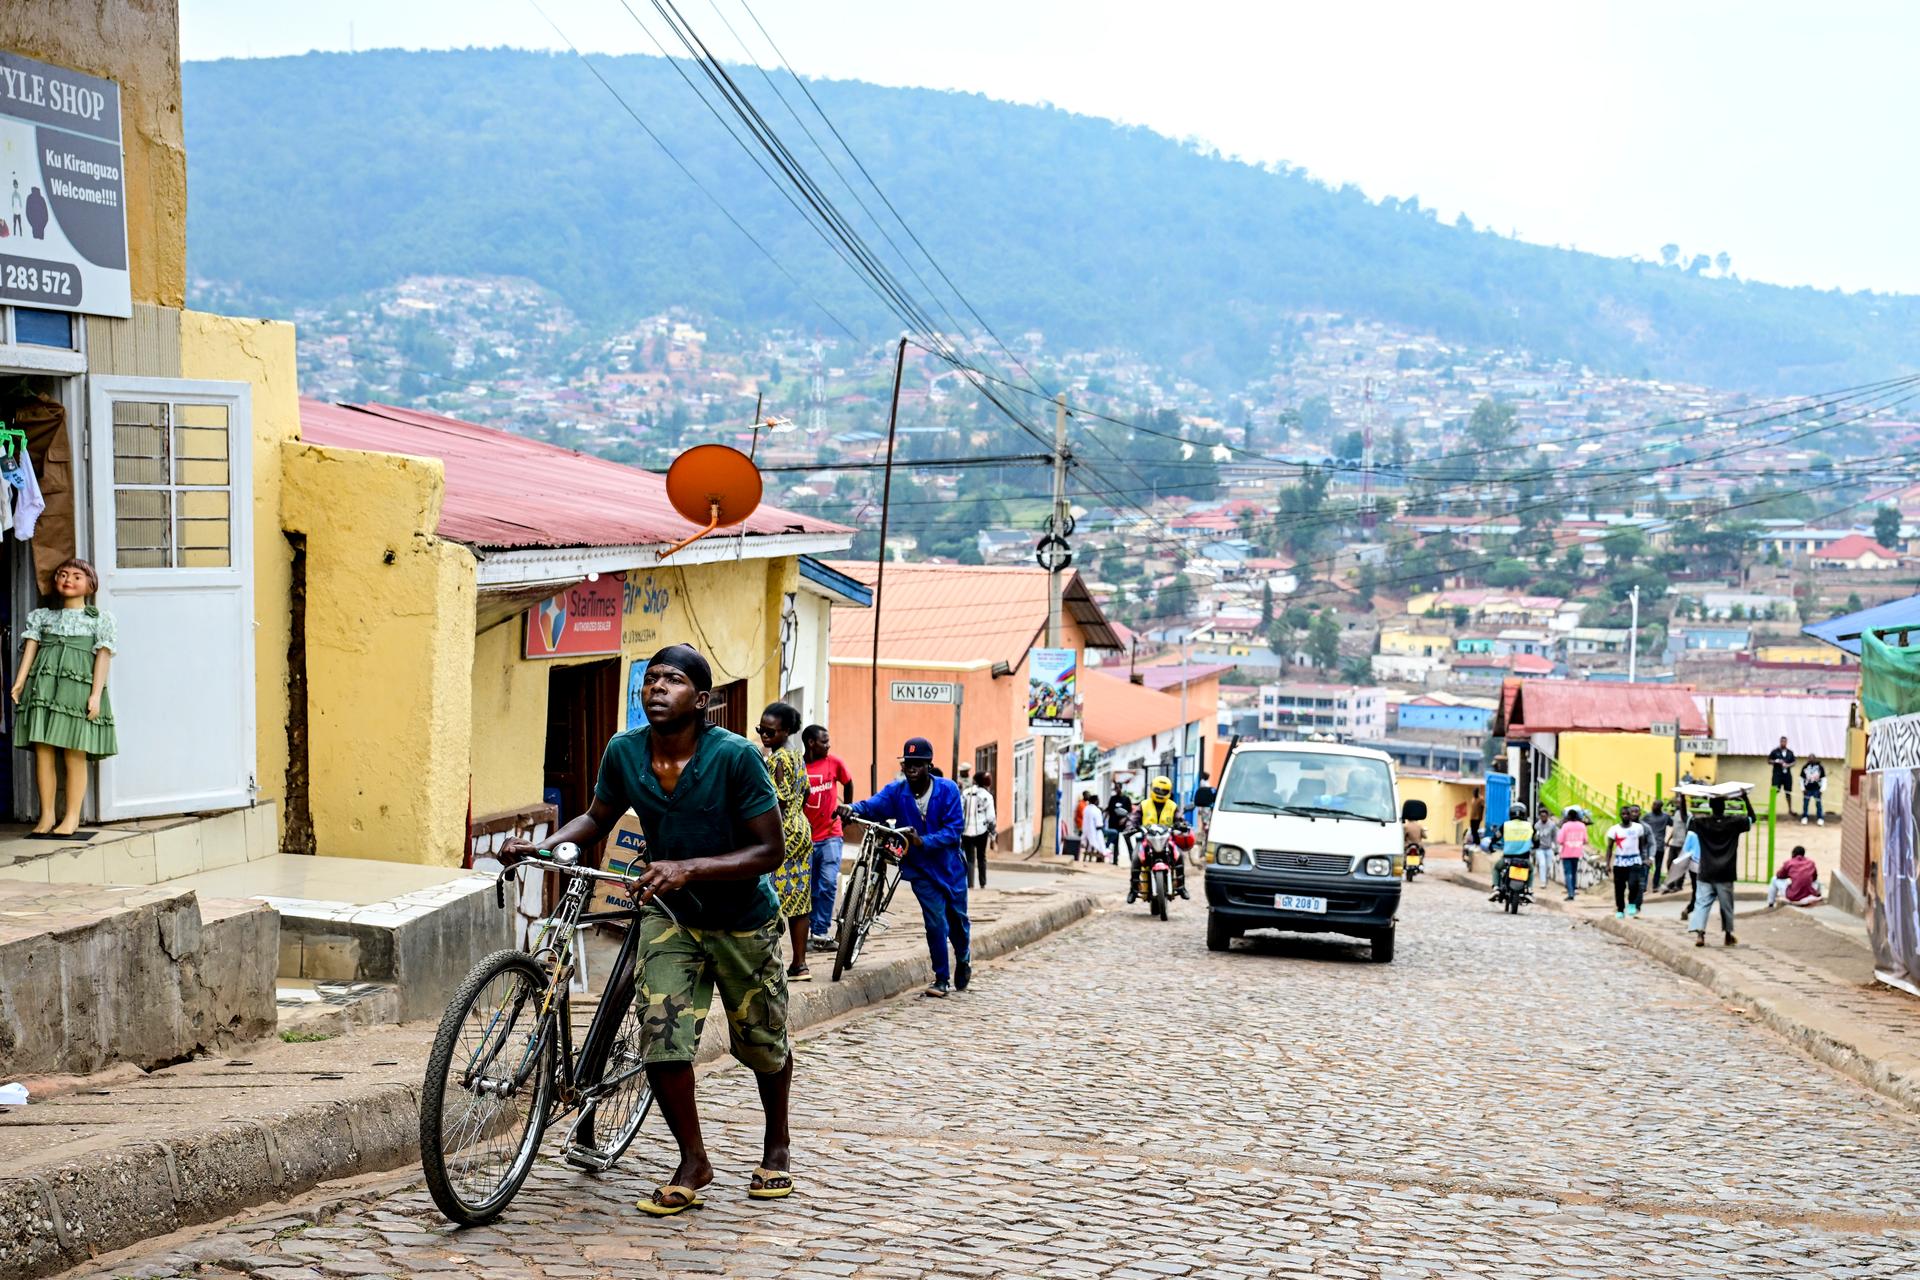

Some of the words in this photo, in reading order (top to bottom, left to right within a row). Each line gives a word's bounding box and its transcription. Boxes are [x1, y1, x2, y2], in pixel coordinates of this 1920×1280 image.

[0, 66, 45, 107] YLE
[49, 80, 104, 121] SHOP
[46, 149, 61, 168] Ku
[63, 153, 119, 180] Kiranguzo
[6, 264, 39, 291] 283
[42, 269, 72, 295] 572
[570, 590, 616, 617] StarTimes
[643, 575, 669, 622] Shop
[597, 620, 611, 631] DEALER
[1282, 896, 1293, 907] GR
